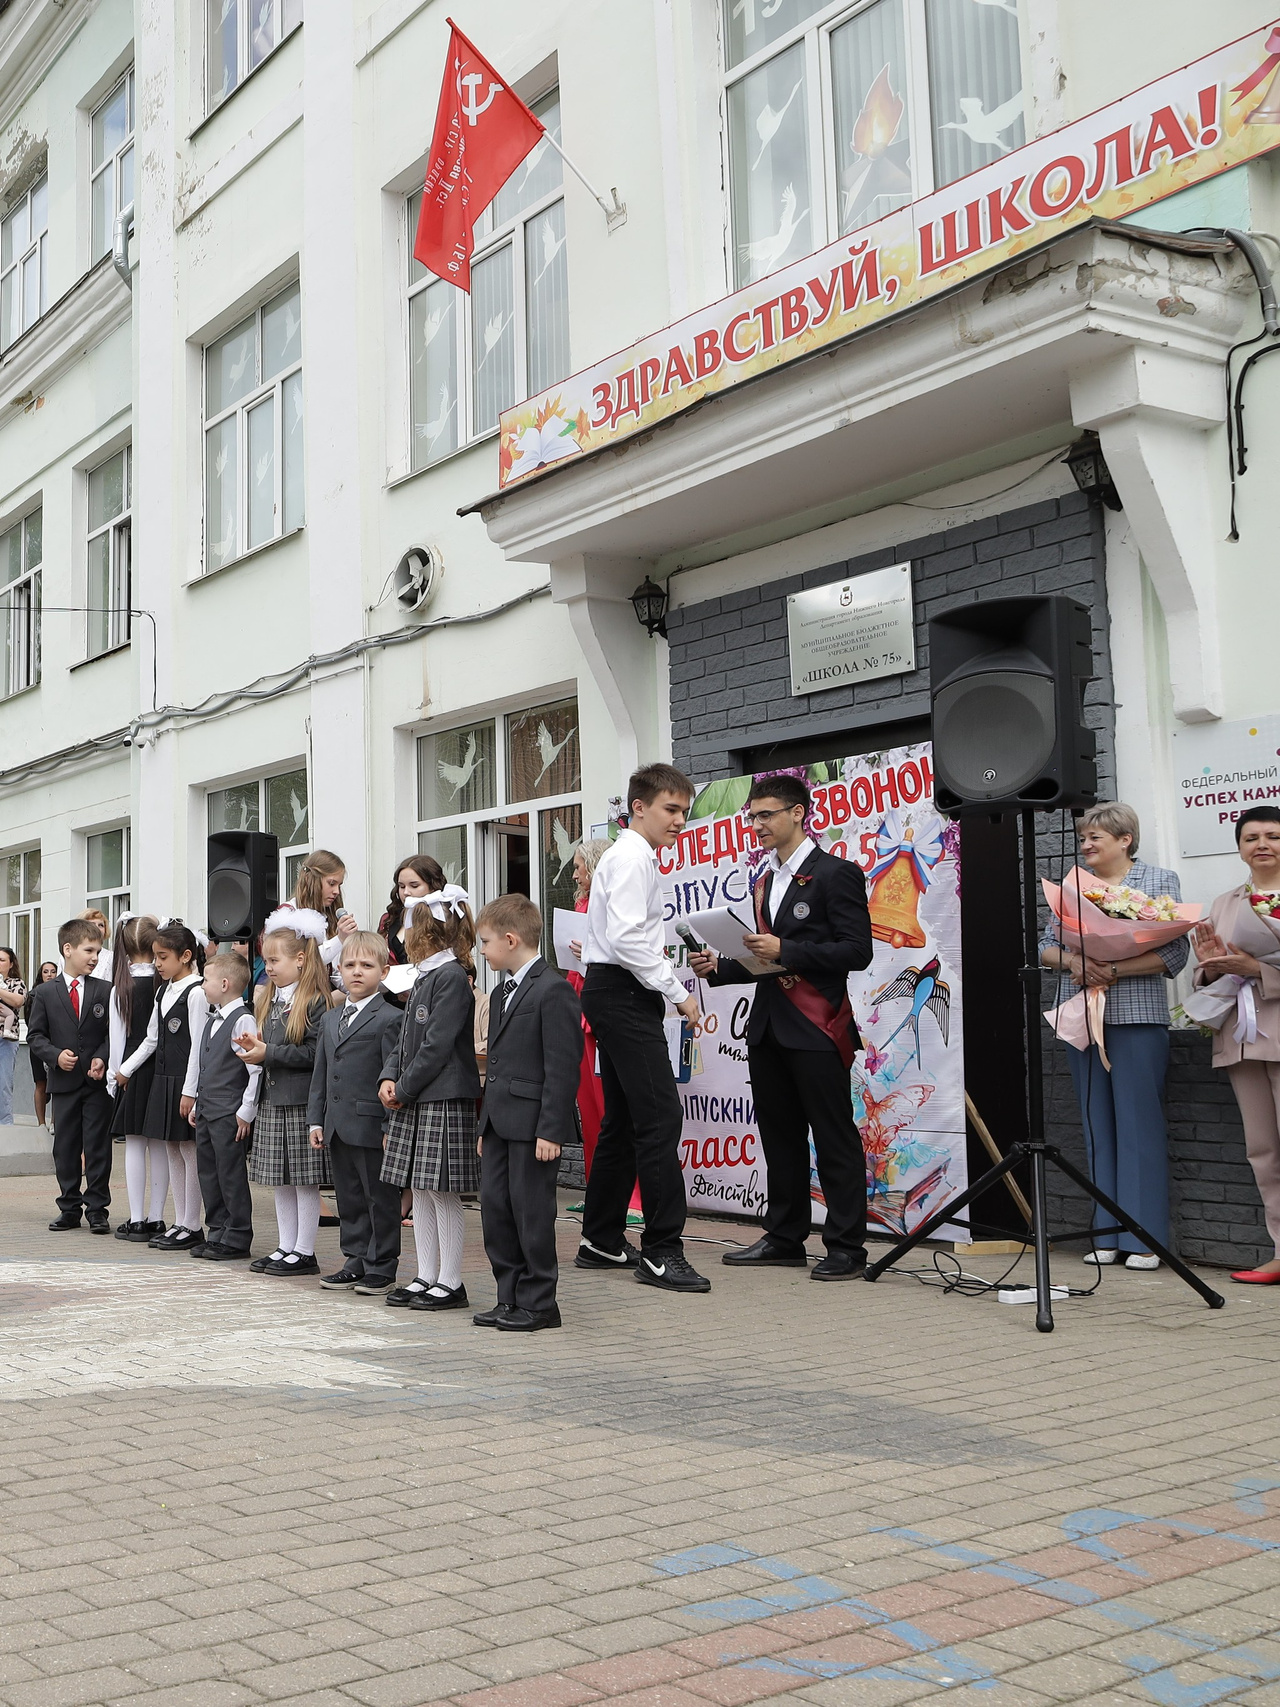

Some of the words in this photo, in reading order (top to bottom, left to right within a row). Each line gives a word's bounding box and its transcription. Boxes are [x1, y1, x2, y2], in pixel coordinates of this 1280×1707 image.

[591, 238, 898, 430] ЗДРАВСТВУЙ,
[917, 83, 1218, 277] ШКОЛА!
[800, 630, 856, 649] МУНИЦИПАЛЬНОЕ
[856, 619, 900, 636] БЮДЖЕТНОЕ
[810, 630, 888, 654] ОБЩЕОБРАЗОВАТЕЛЬНОЕ
[827, 642, 871, 658] УЧРЕЖДЕНИЕ
[801, 660, 860, 684] «ШКОЛА
[862, 656, 879, 671] №
[882, 651, 902, 666] 75»
[1181, 765, 1278, 789] ФЕДЕРАЛЬНЫЙ
[1183, 790, 1239, 809] УСПЕХ
[655, 814, 764, 875] СЛЕДН
[683, 1094, 757, 1126] ПУСКНИ
[679, 1133, 757, 1171] ласс
[689, 1169, 769, 1217] Действу
